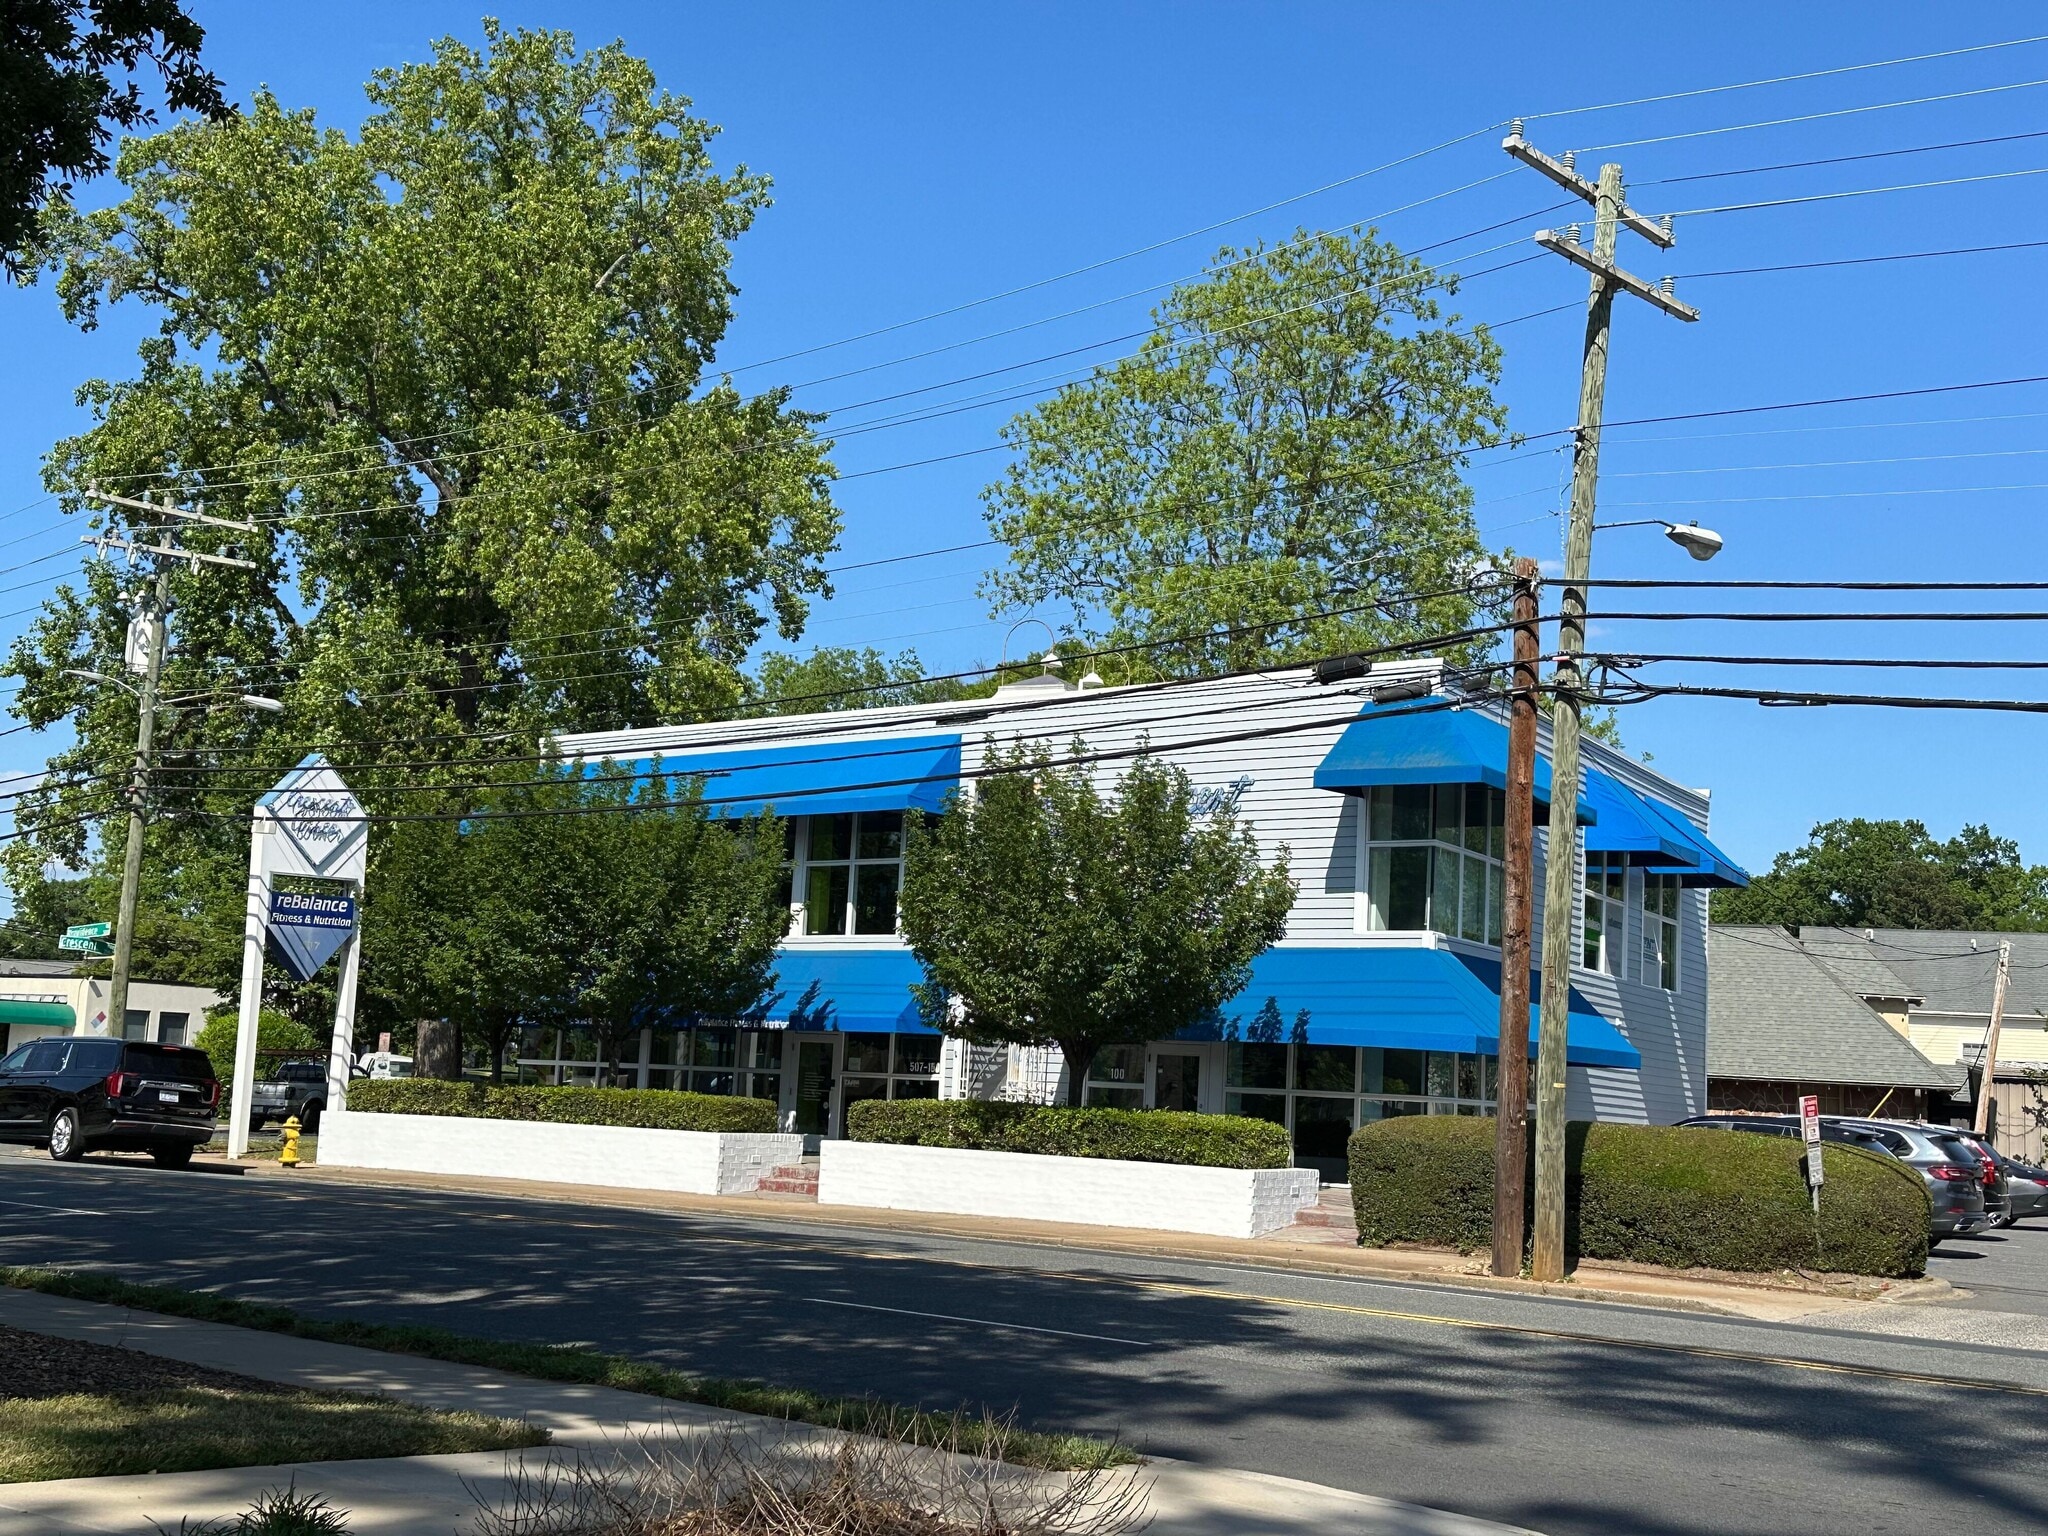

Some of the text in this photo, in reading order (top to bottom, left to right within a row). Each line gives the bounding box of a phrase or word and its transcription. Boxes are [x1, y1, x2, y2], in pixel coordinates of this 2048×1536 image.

[276, 894, 348, 913] reBalance
[271, 912, 352, 927] Fitness & Nutrition
[62, 937, 97, 951] Crescent
[1110, 1067, 1125, 1080] 100
